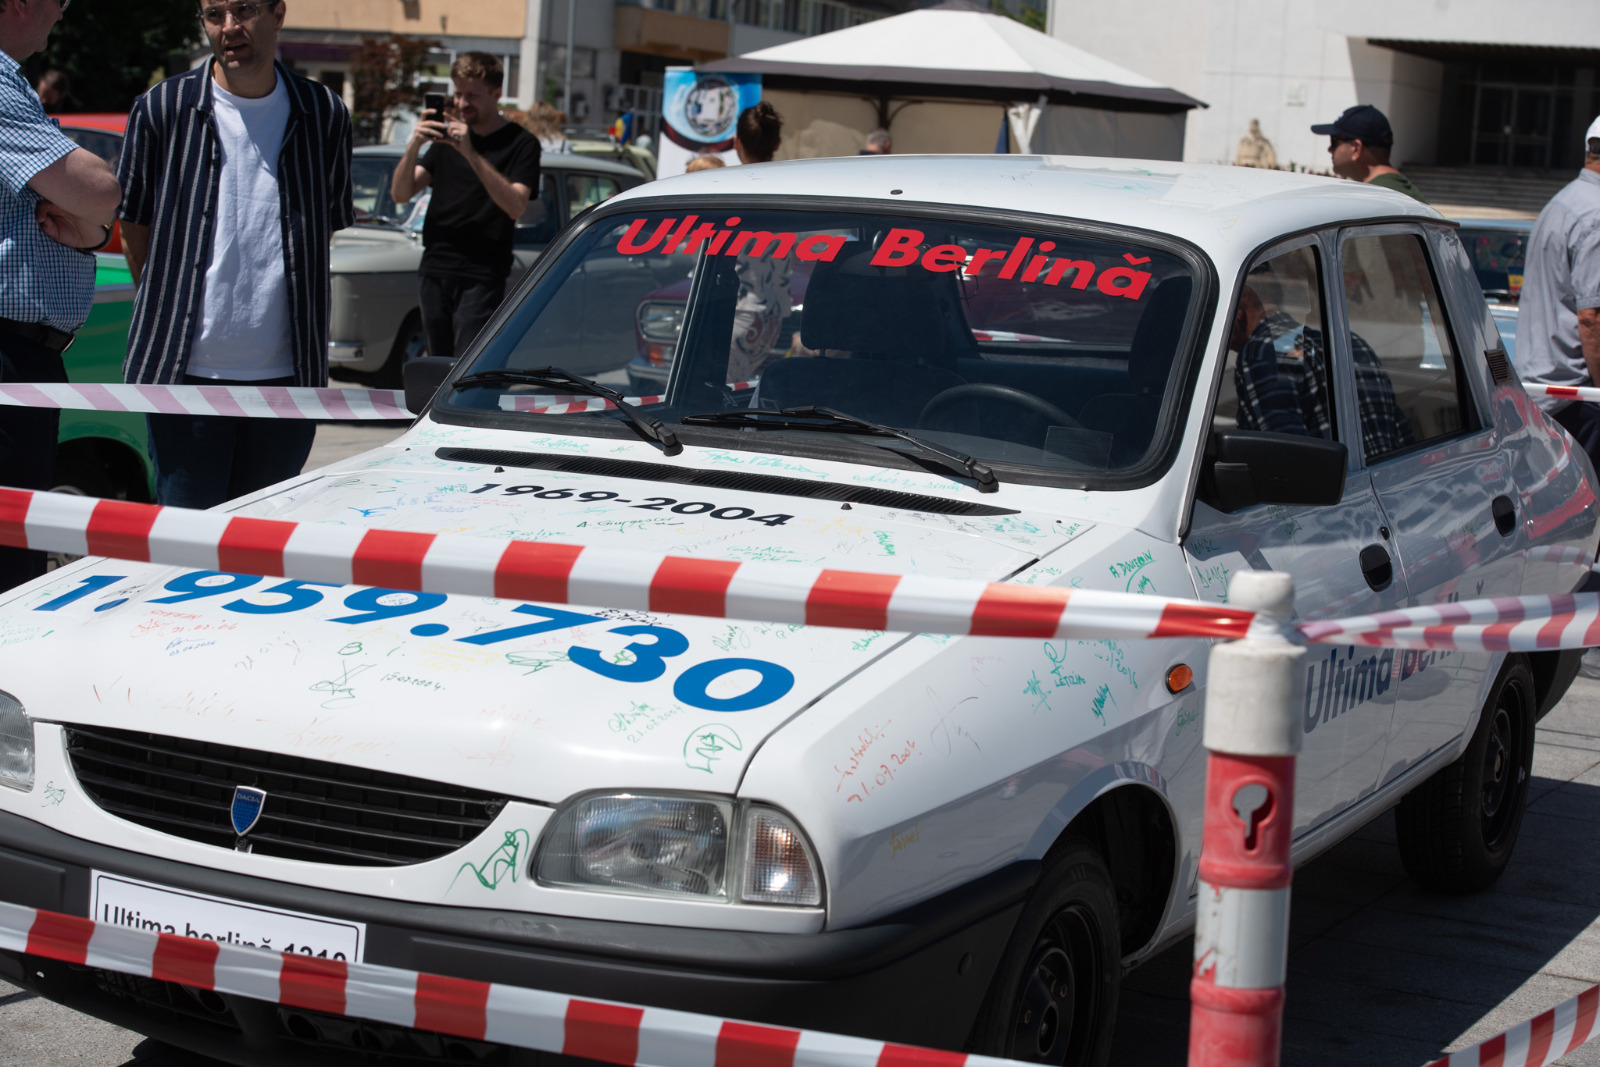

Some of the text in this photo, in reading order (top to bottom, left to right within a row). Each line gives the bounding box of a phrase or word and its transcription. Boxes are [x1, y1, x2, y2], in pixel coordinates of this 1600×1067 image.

[616, 215, 1152, 300] Ultima Berlină
[470, 483, 795, 527] 1969-2004
[32, 569, 795, 712] 1.959.730
[1303, 645, 1395, 734] Ultima
[236, 792, 260, 804] DACIA
